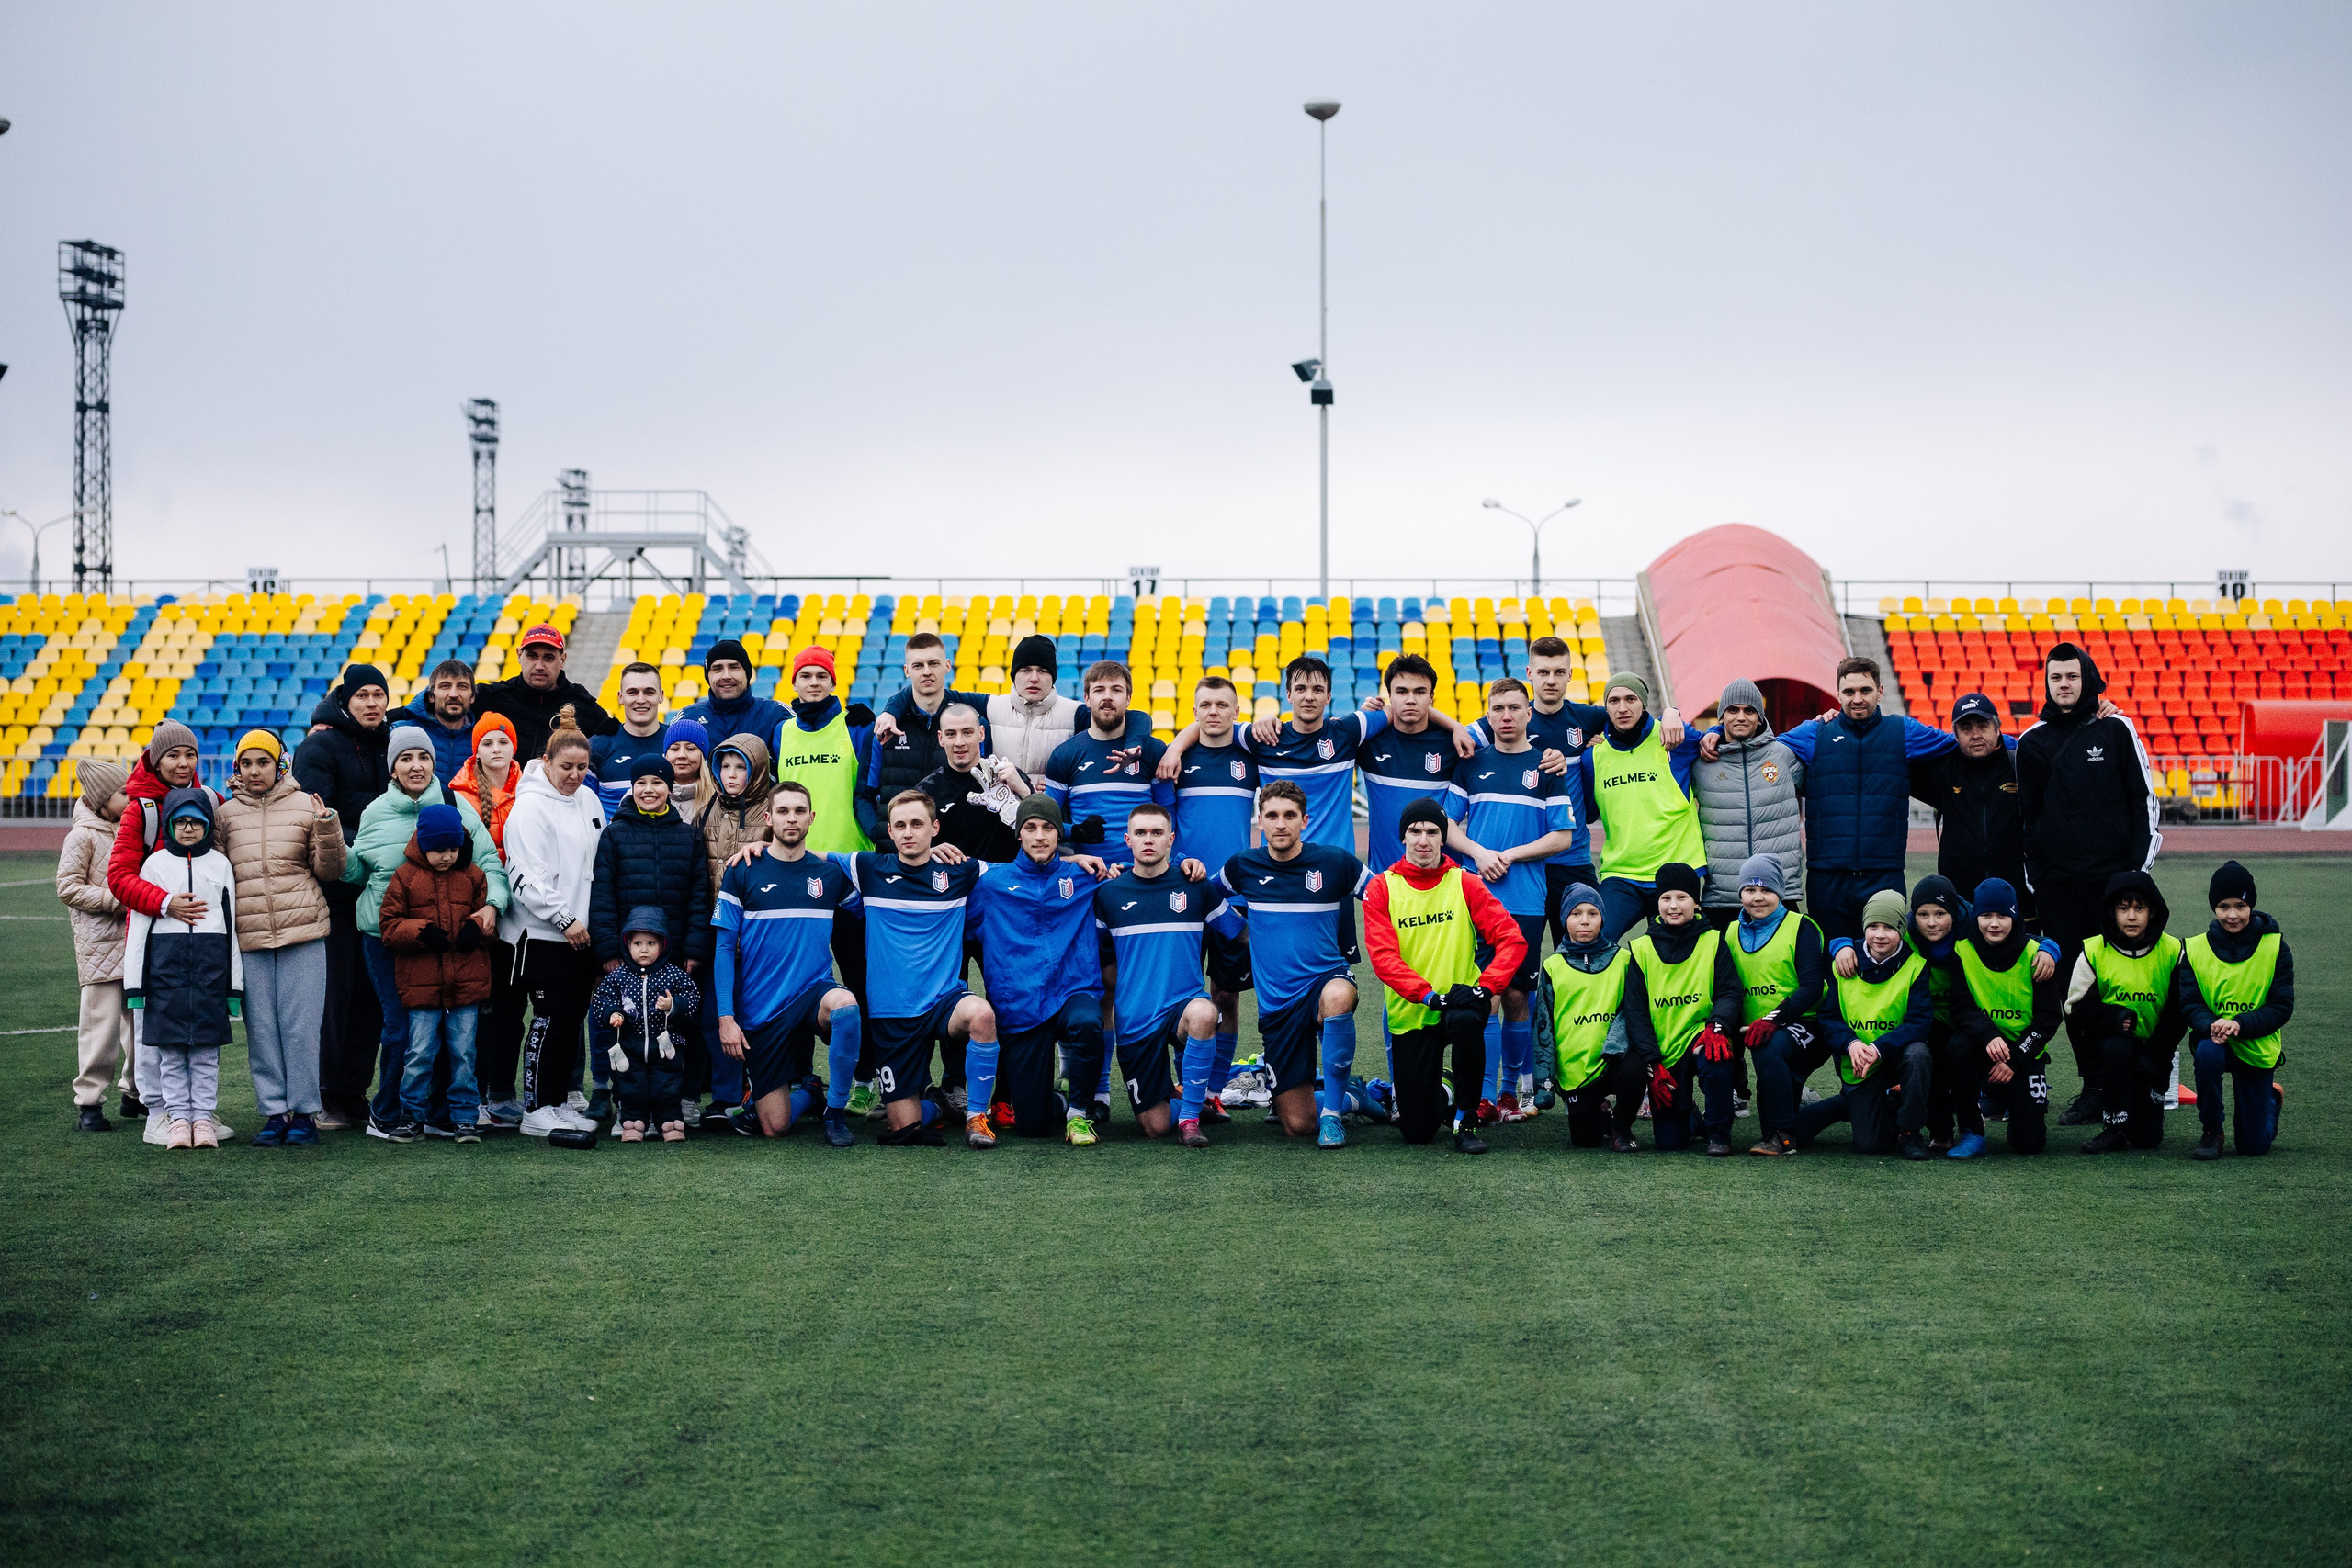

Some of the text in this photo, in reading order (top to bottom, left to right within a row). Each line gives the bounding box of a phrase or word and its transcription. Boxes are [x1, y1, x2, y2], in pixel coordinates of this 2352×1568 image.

[1133, 580, 1157, 599] 17
[786, 754, 829, 767] KELME
[1603, 773, 1646, 789] KELME
[1398, 912, 1445, 928] KELME
[1745, 985, 1777, 997] AMOS
[2116, 992, 2157, 1002] VAMOS
[1654, 993, 1700, 1008] VAMOS
[1574, 1013, 1616, 1026] VAMOS
[1981, 1008, 2022, 1020] AMOS
[1849, 1020, 1895, 1031] VAMOS
[1787, 1023, 1815, 1049] 21
[1126, 1078, 1142, 1105] 7
[2029, 1074, 2047, 1098] 55
